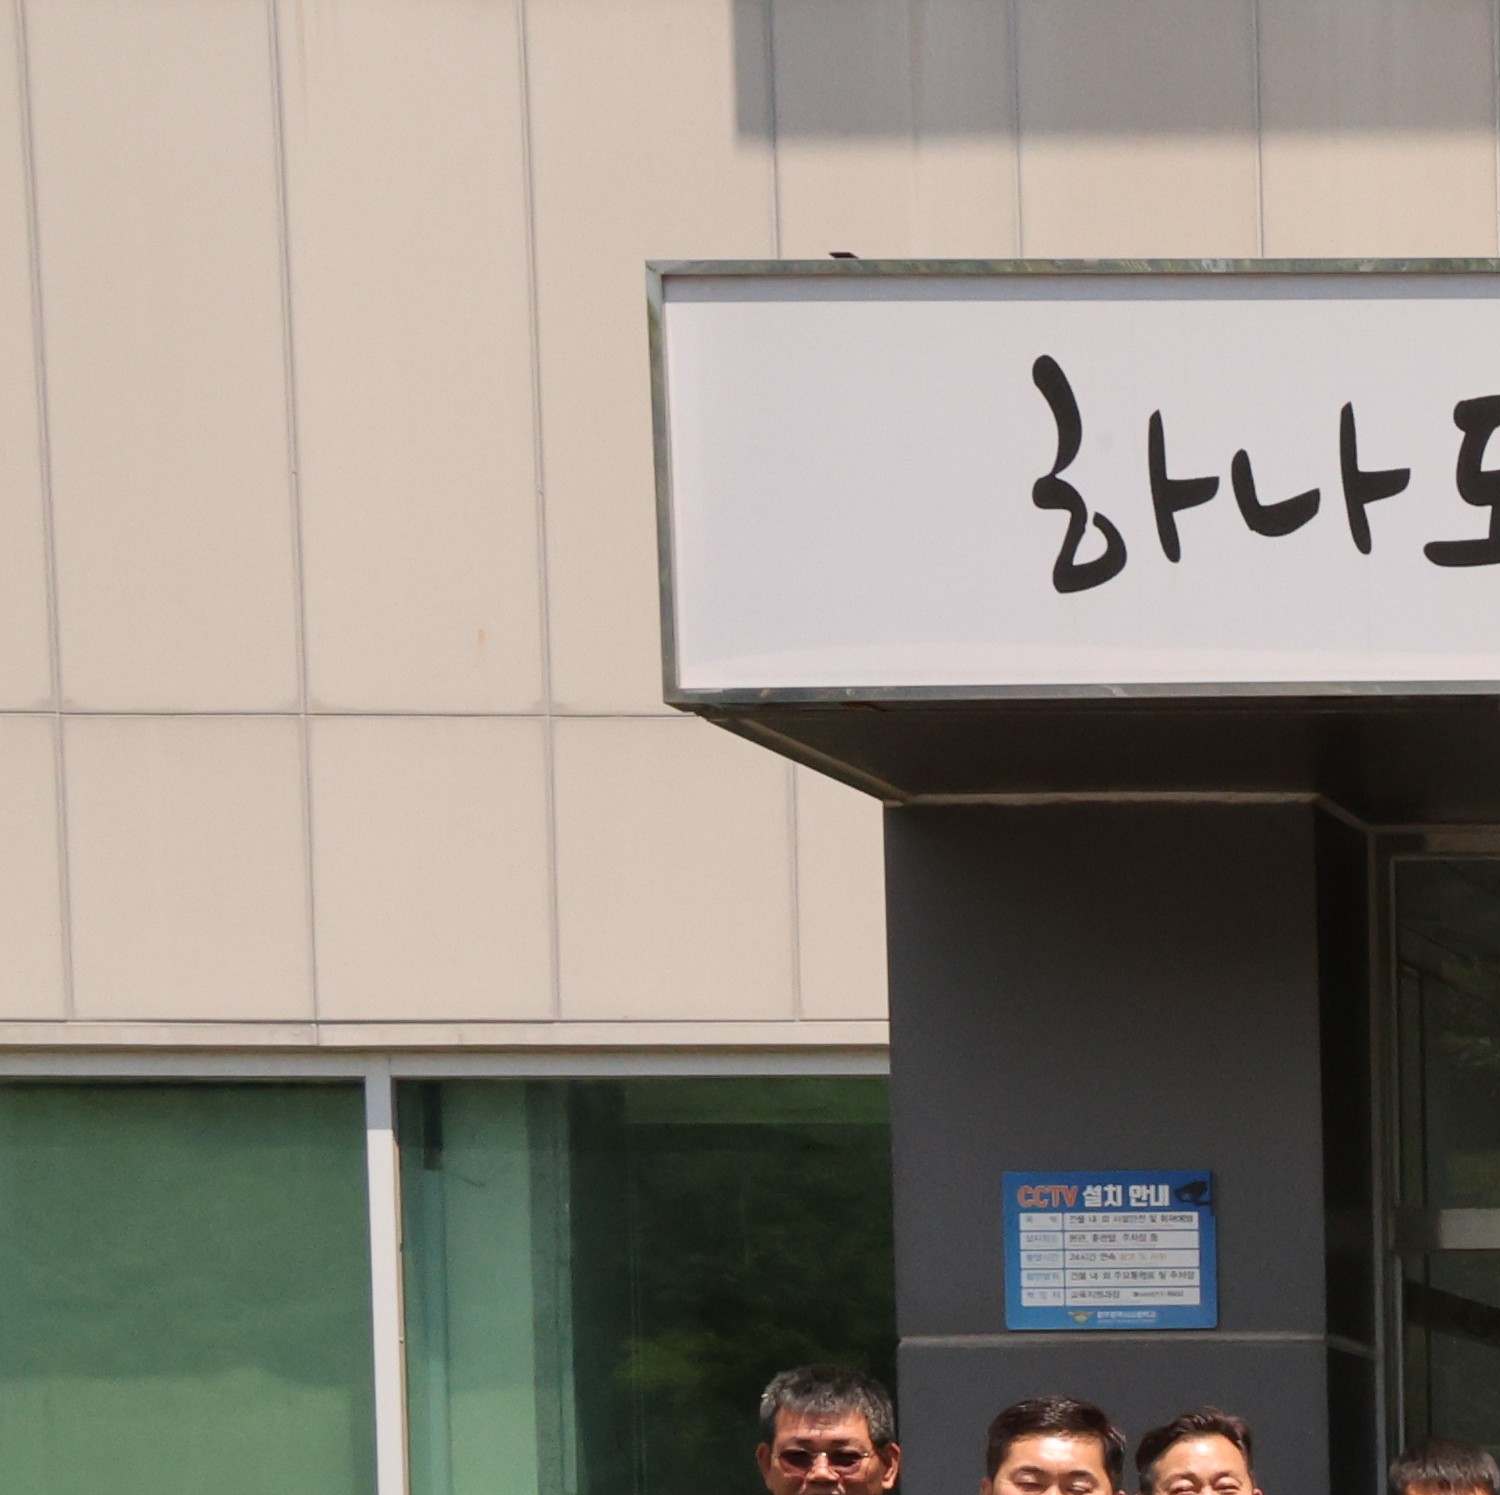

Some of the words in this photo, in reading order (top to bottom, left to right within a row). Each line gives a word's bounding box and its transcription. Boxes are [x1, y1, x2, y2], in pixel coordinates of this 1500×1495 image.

[1017, 1184, 1079, 1208] CCTV
[1082, 1184, 1122, 1208] 설치
[1128, 1184, 1170, 1207] 안내
